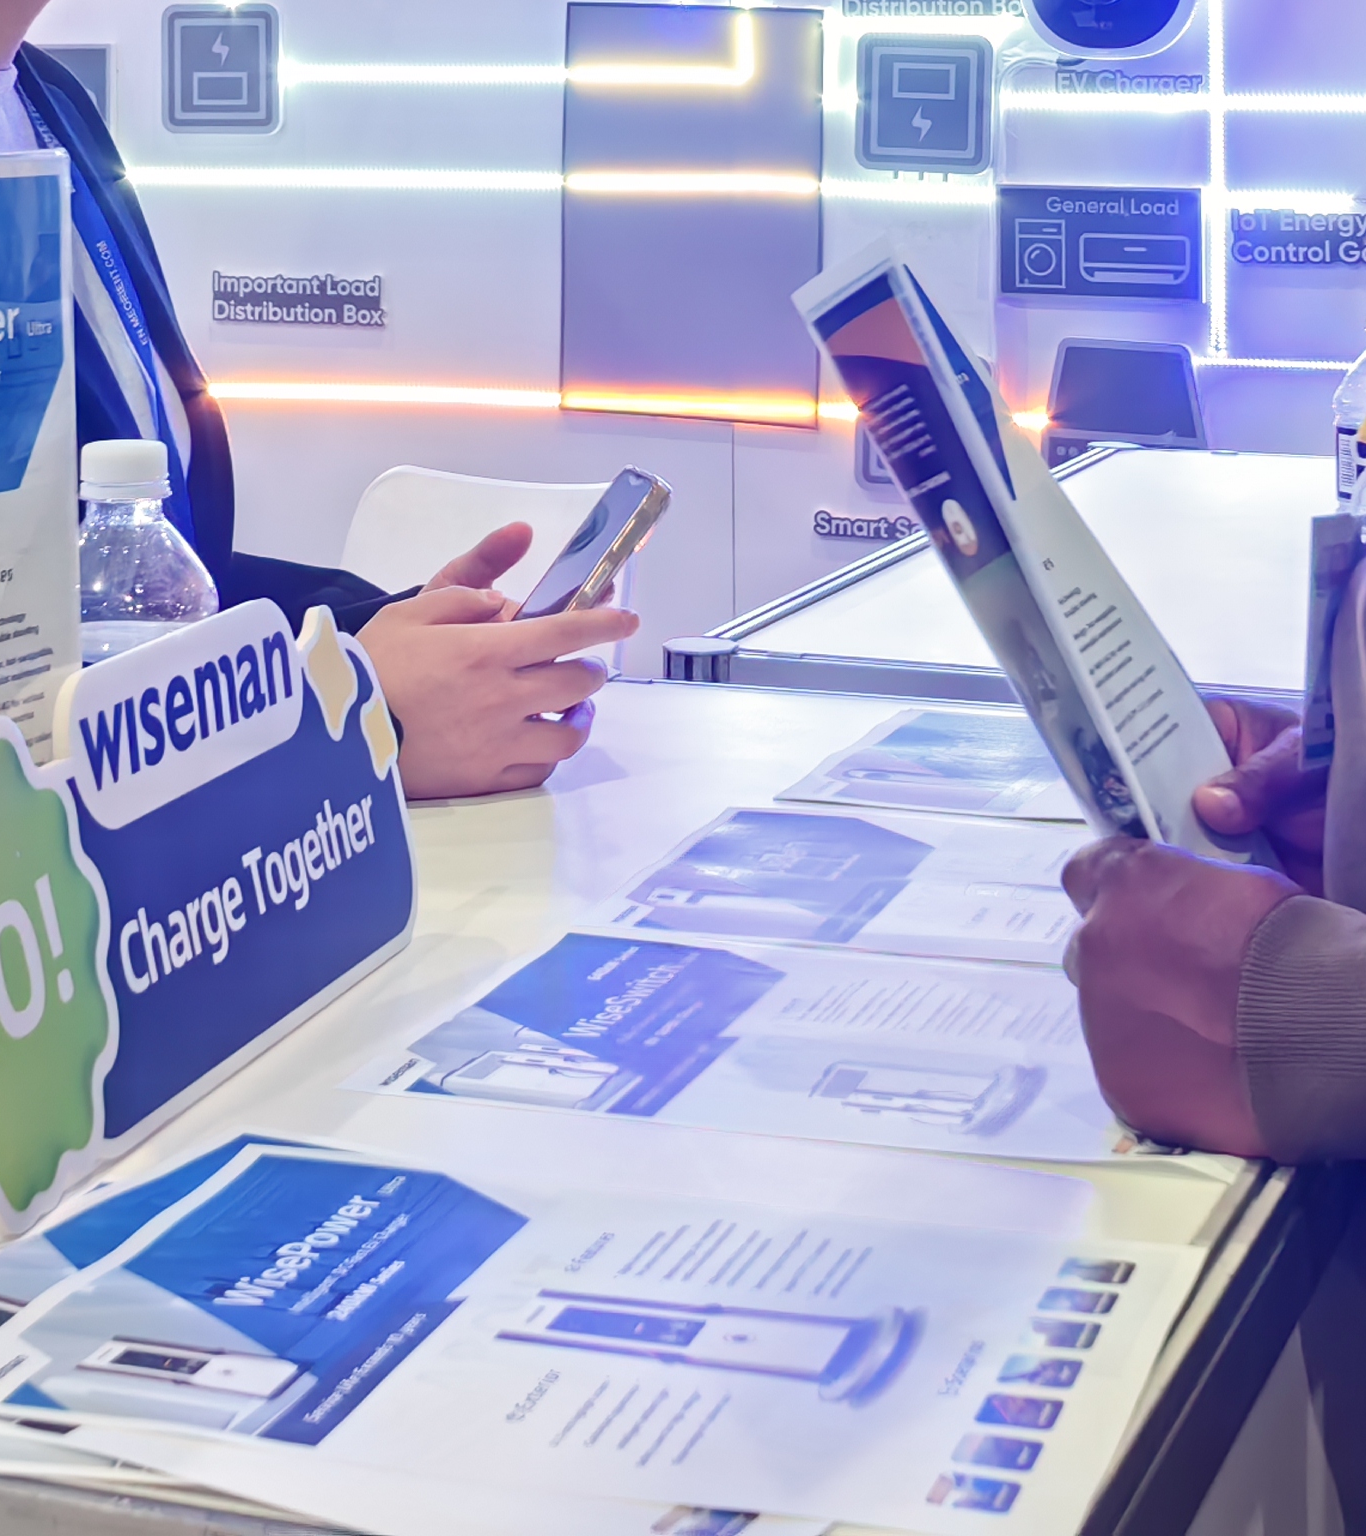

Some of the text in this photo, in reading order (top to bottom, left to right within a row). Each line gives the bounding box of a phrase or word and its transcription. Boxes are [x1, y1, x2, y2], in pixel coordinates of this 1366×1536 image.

[1046, 197, 1179, 215] General Load
[1233, 240, 1331, 262] Control
[213, 272, 380, 298] Important Load
[213, 301, 383, 325] Distribution Box
[815, 512, 888, 538] Smart
[79, 629, 294, 792] wiseman
[119, 794, 376, 995] Charge Together
[212, 1195, 380, 1306] WisePower
